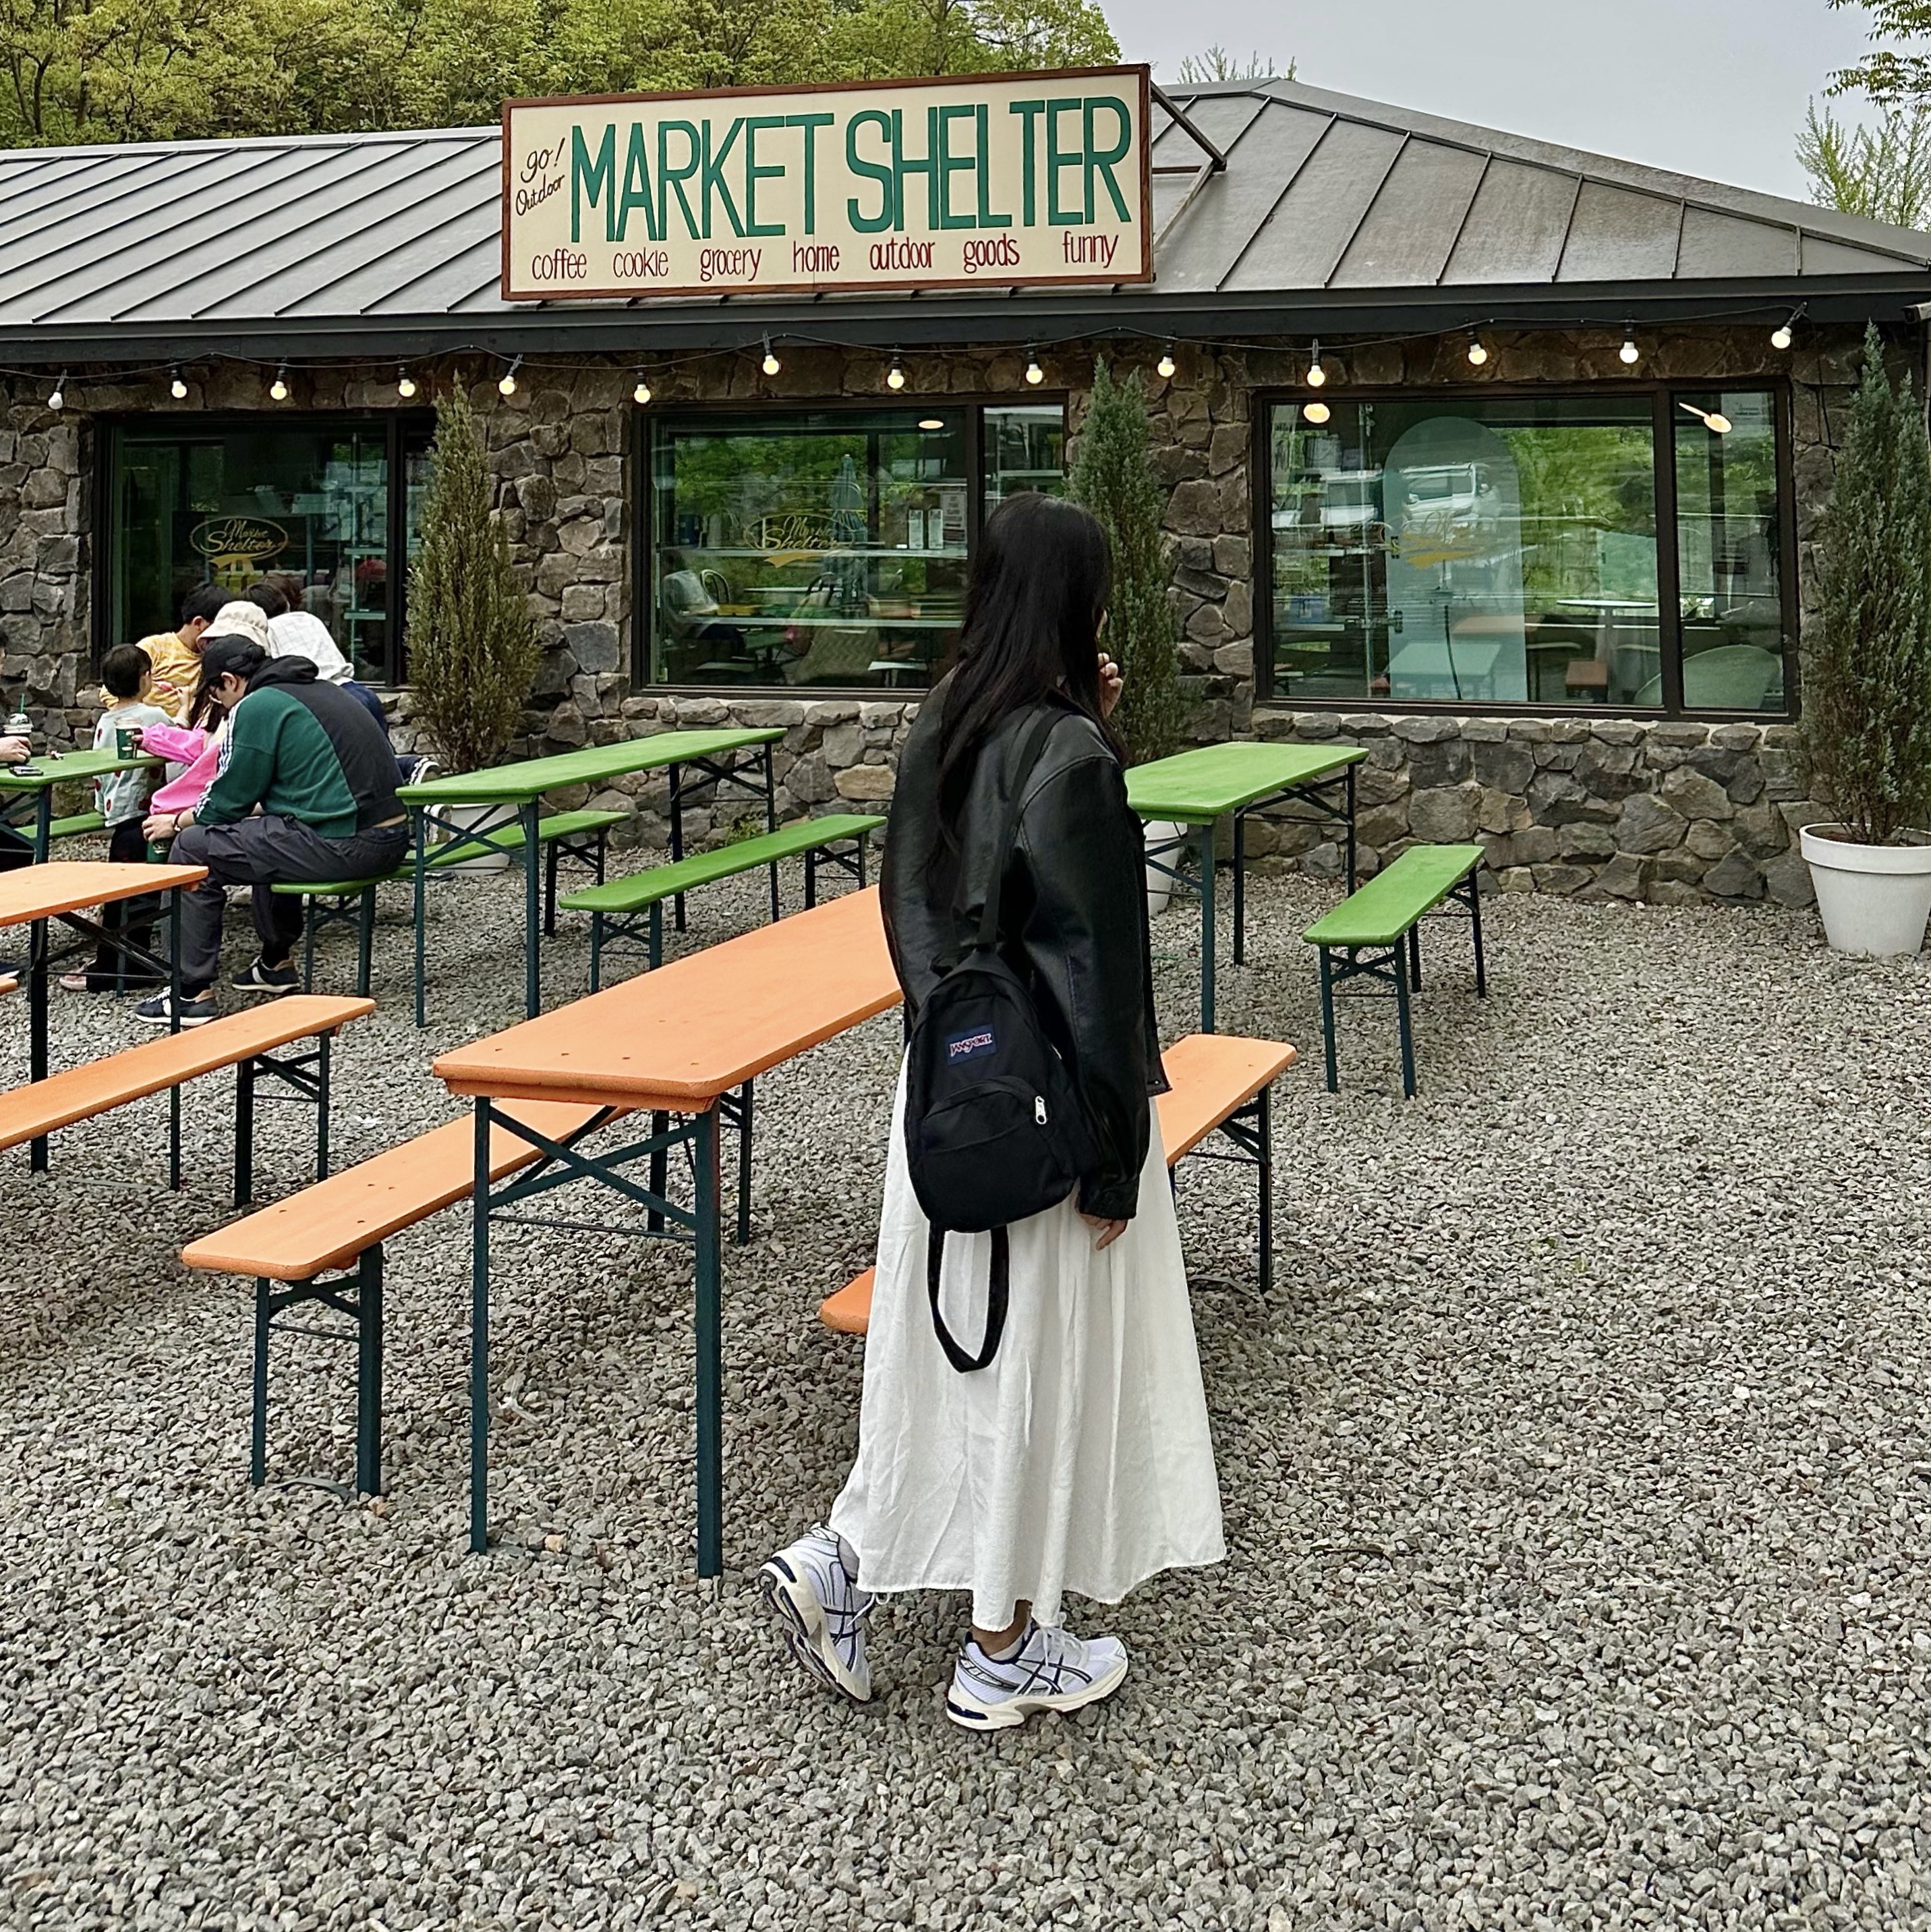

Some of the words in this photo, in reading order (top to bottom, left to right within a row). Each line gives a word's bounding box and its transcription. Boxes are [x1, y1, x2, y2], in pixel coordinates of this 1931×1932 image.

[521, 138, 565, 183] go!
[571, 113, 834, 243] MARKET
[846, 96, 1132, 233] SHELTER
[516, 173, 565, 216] Outdoor
[531, 248, 587, 279] coffee
[613, 247, 668, 277] cookie
[700, 248, 761, 281] grocery
[793, 241, 840, 273] home
[869, 237, 935, 270] outdoor
[963, 233, 1020, 274] goods
[1062, 231, 1118, 268] funny
